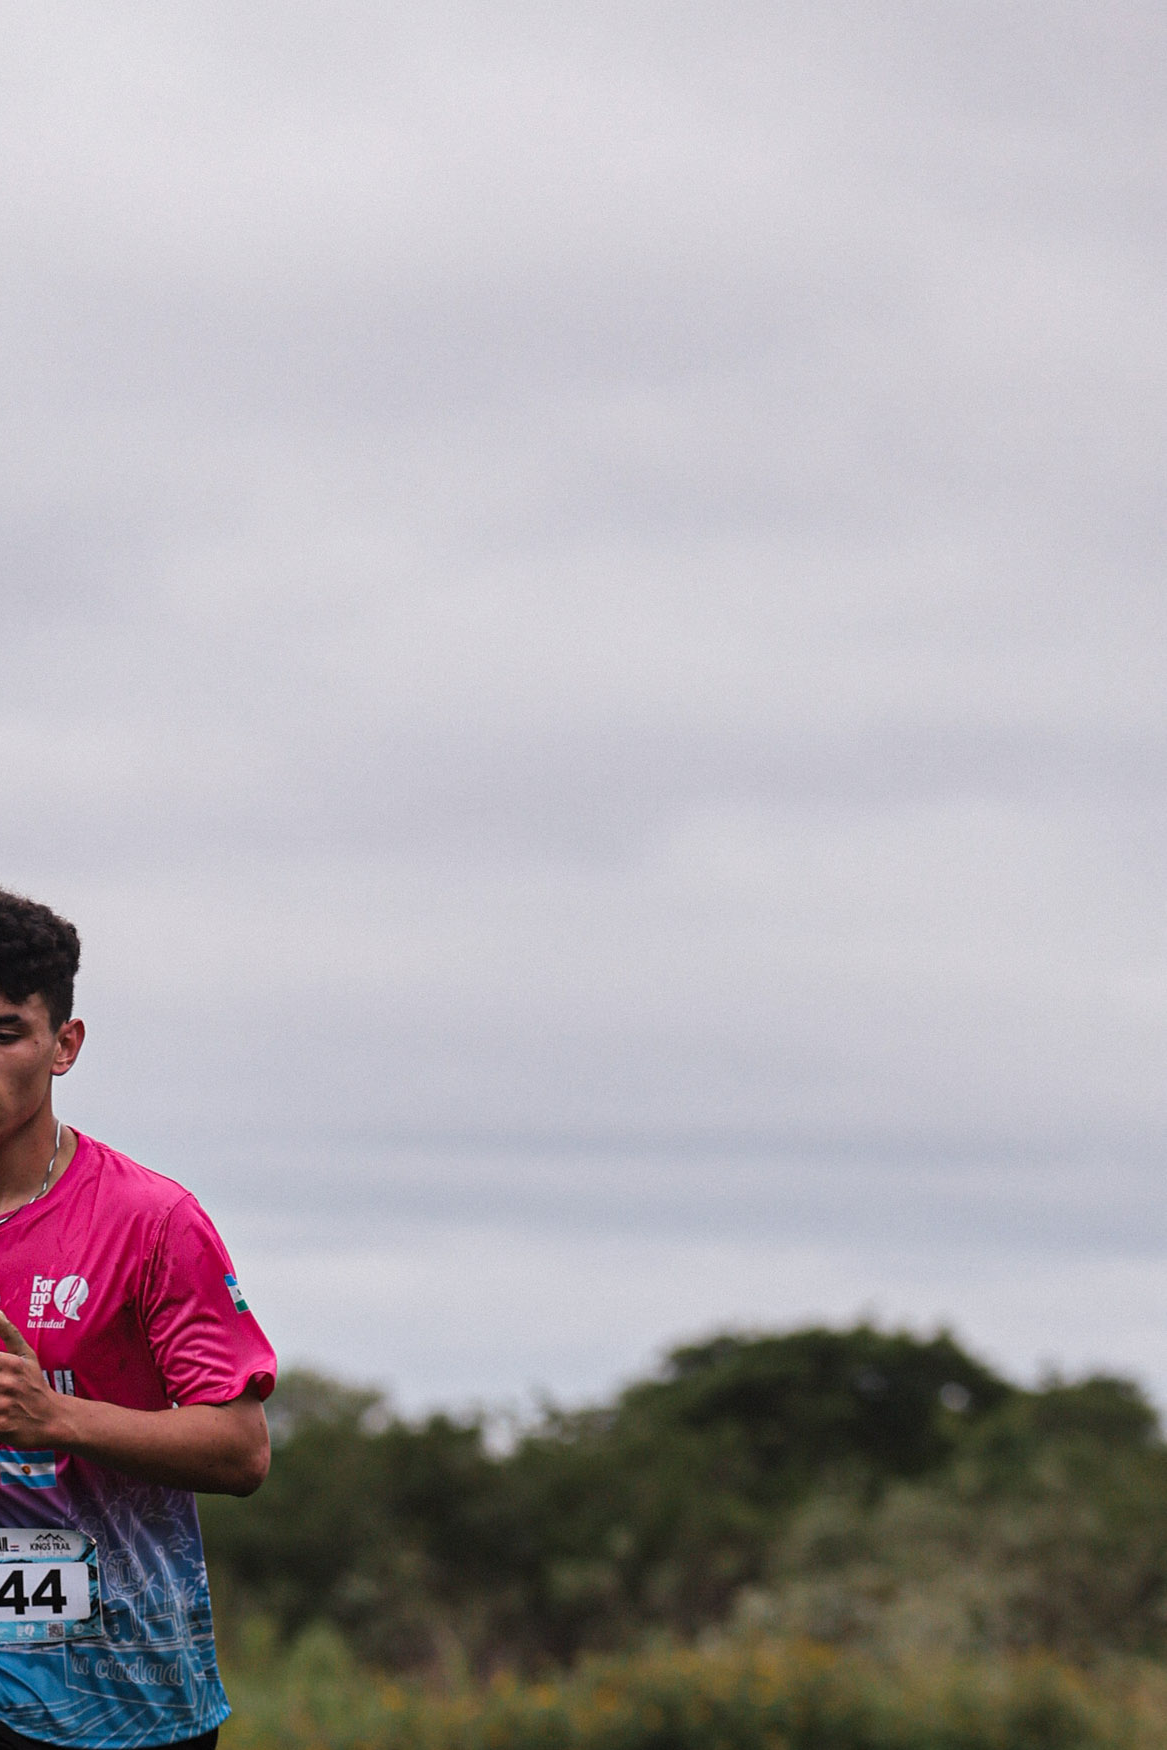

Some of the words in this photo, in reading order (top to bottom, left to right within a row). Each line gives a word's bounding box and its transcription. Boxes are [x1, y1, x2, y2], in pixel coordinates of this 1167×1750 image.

[33, 1275, 55, 1292] For
[30, 1293, 51, 1305] mo
[28, 1305, 44, 1317] sa
[30, 1543, 51, 1551] KINGS
[53, 1542, 71, 1551] TRAIL
[95, 1655, 184, 1687] ciudad
